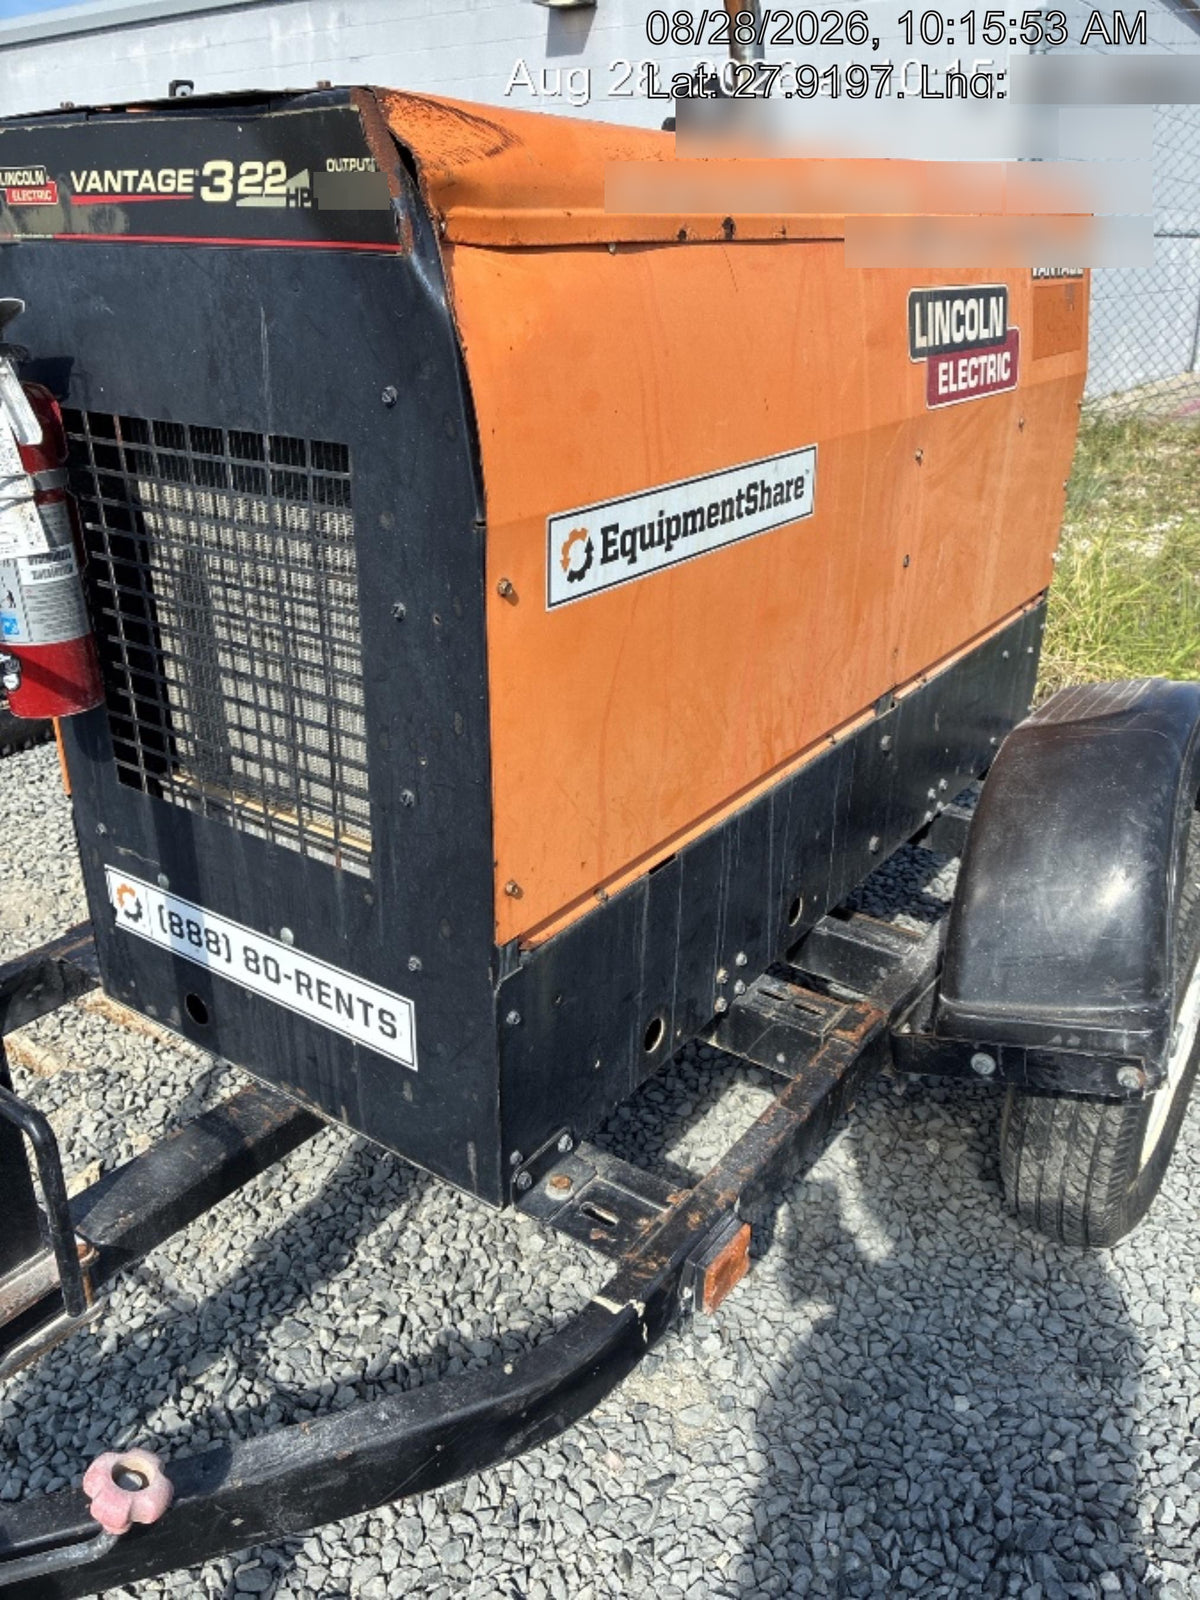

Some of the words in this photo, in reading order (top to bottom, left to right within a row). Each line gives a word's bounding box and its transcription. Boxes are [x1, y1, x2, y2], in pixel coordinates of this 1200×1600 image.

[0, 169, 45, 187] LINCOLN
[12, 189, 53, 202] ELECTRIC
[70, 168, 195, 194] VANTAGE
[914, 296, 1004, 349] LINCOLN
[937, 352, 1012, 395] ELECTRIC
[600, 475, 806, 565] EquipmentShare
[157, 904, 232, 964] (888)
[243, 945, 399, 1040] 80-RENTS
